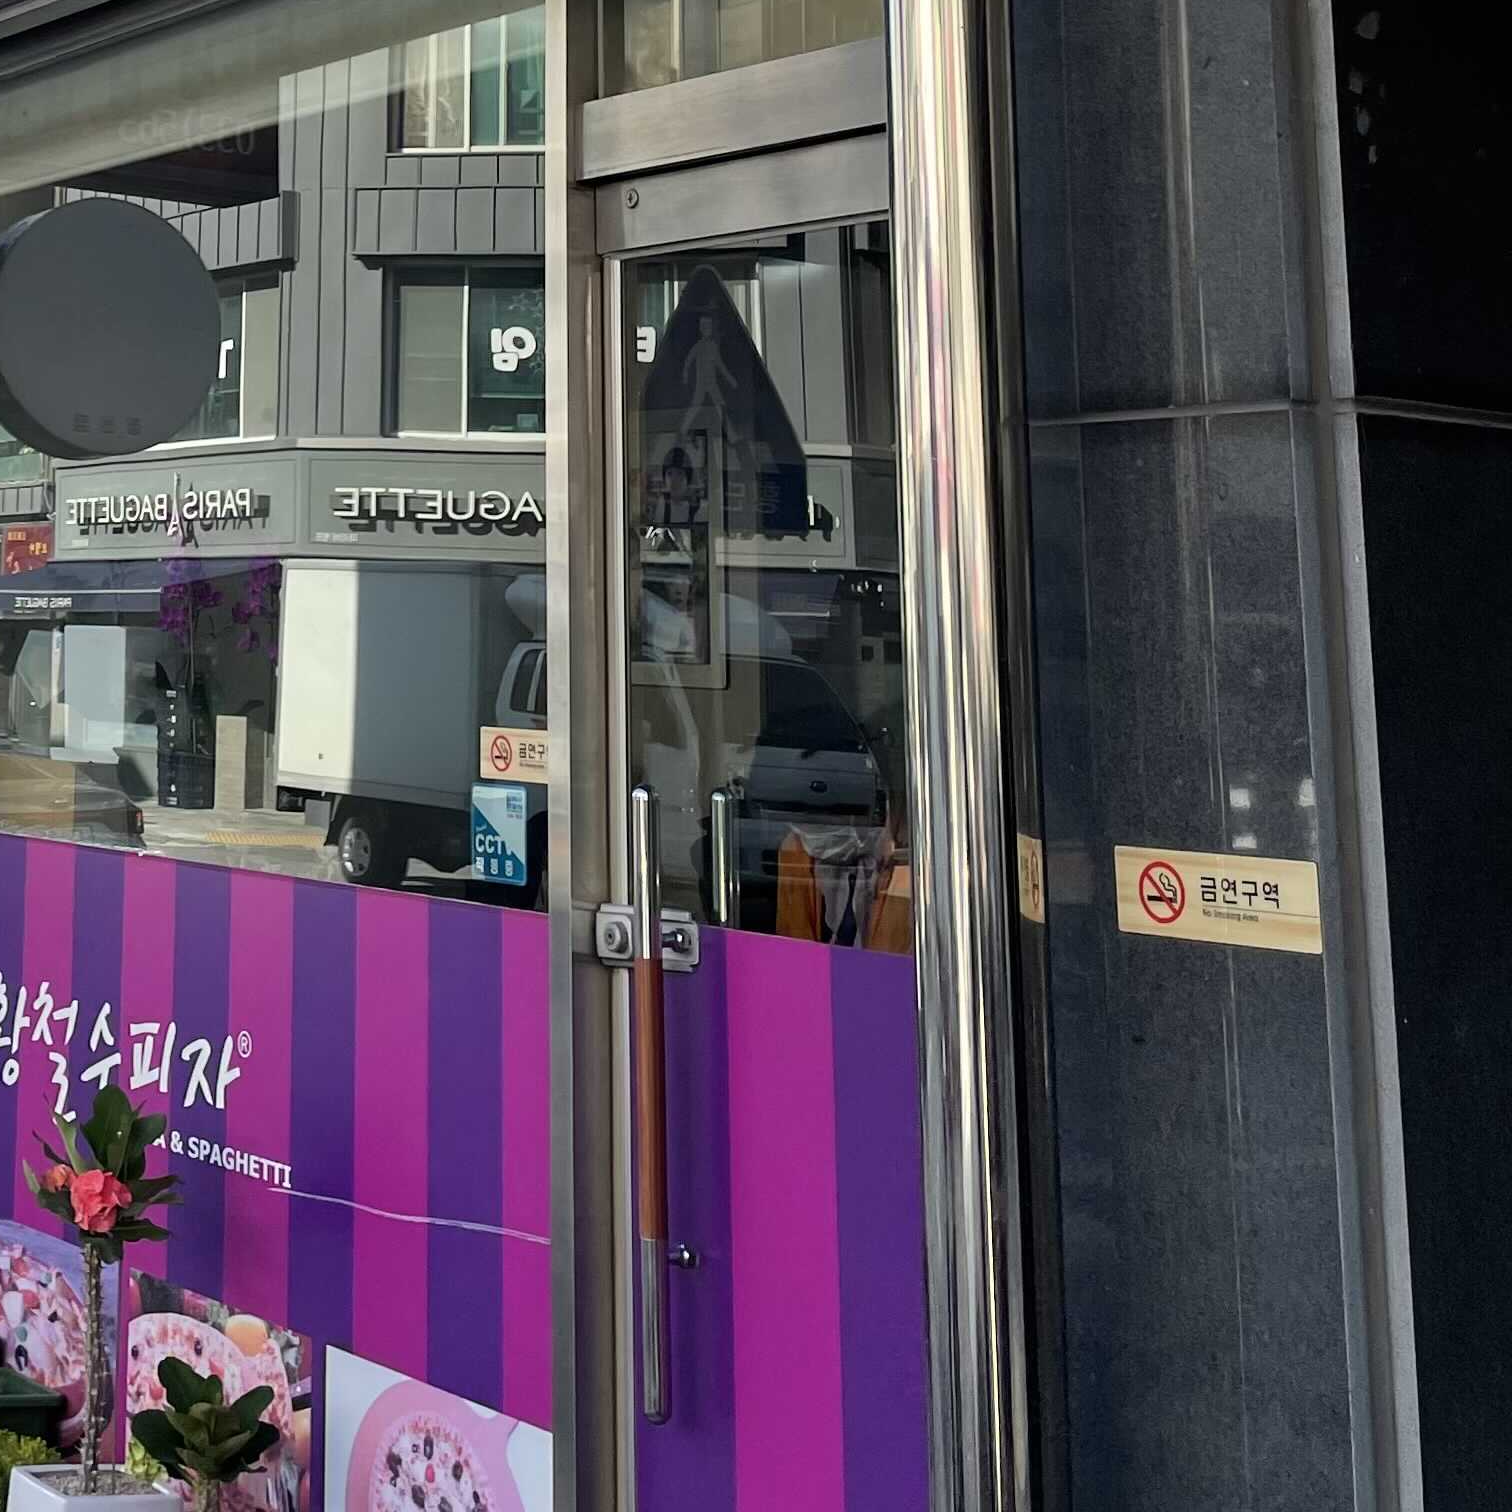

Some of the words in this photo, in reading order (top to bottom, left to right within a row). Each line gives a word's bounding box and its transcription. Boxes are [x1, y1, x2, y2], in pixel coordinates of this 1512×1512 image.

[519, 742, 548, 760] 금연구
[1200, 876, 1280, 909] 금연구역
[170, 1130, 184, 1155] &
[187, 1136, 292, 1189] SPAGHETTI
